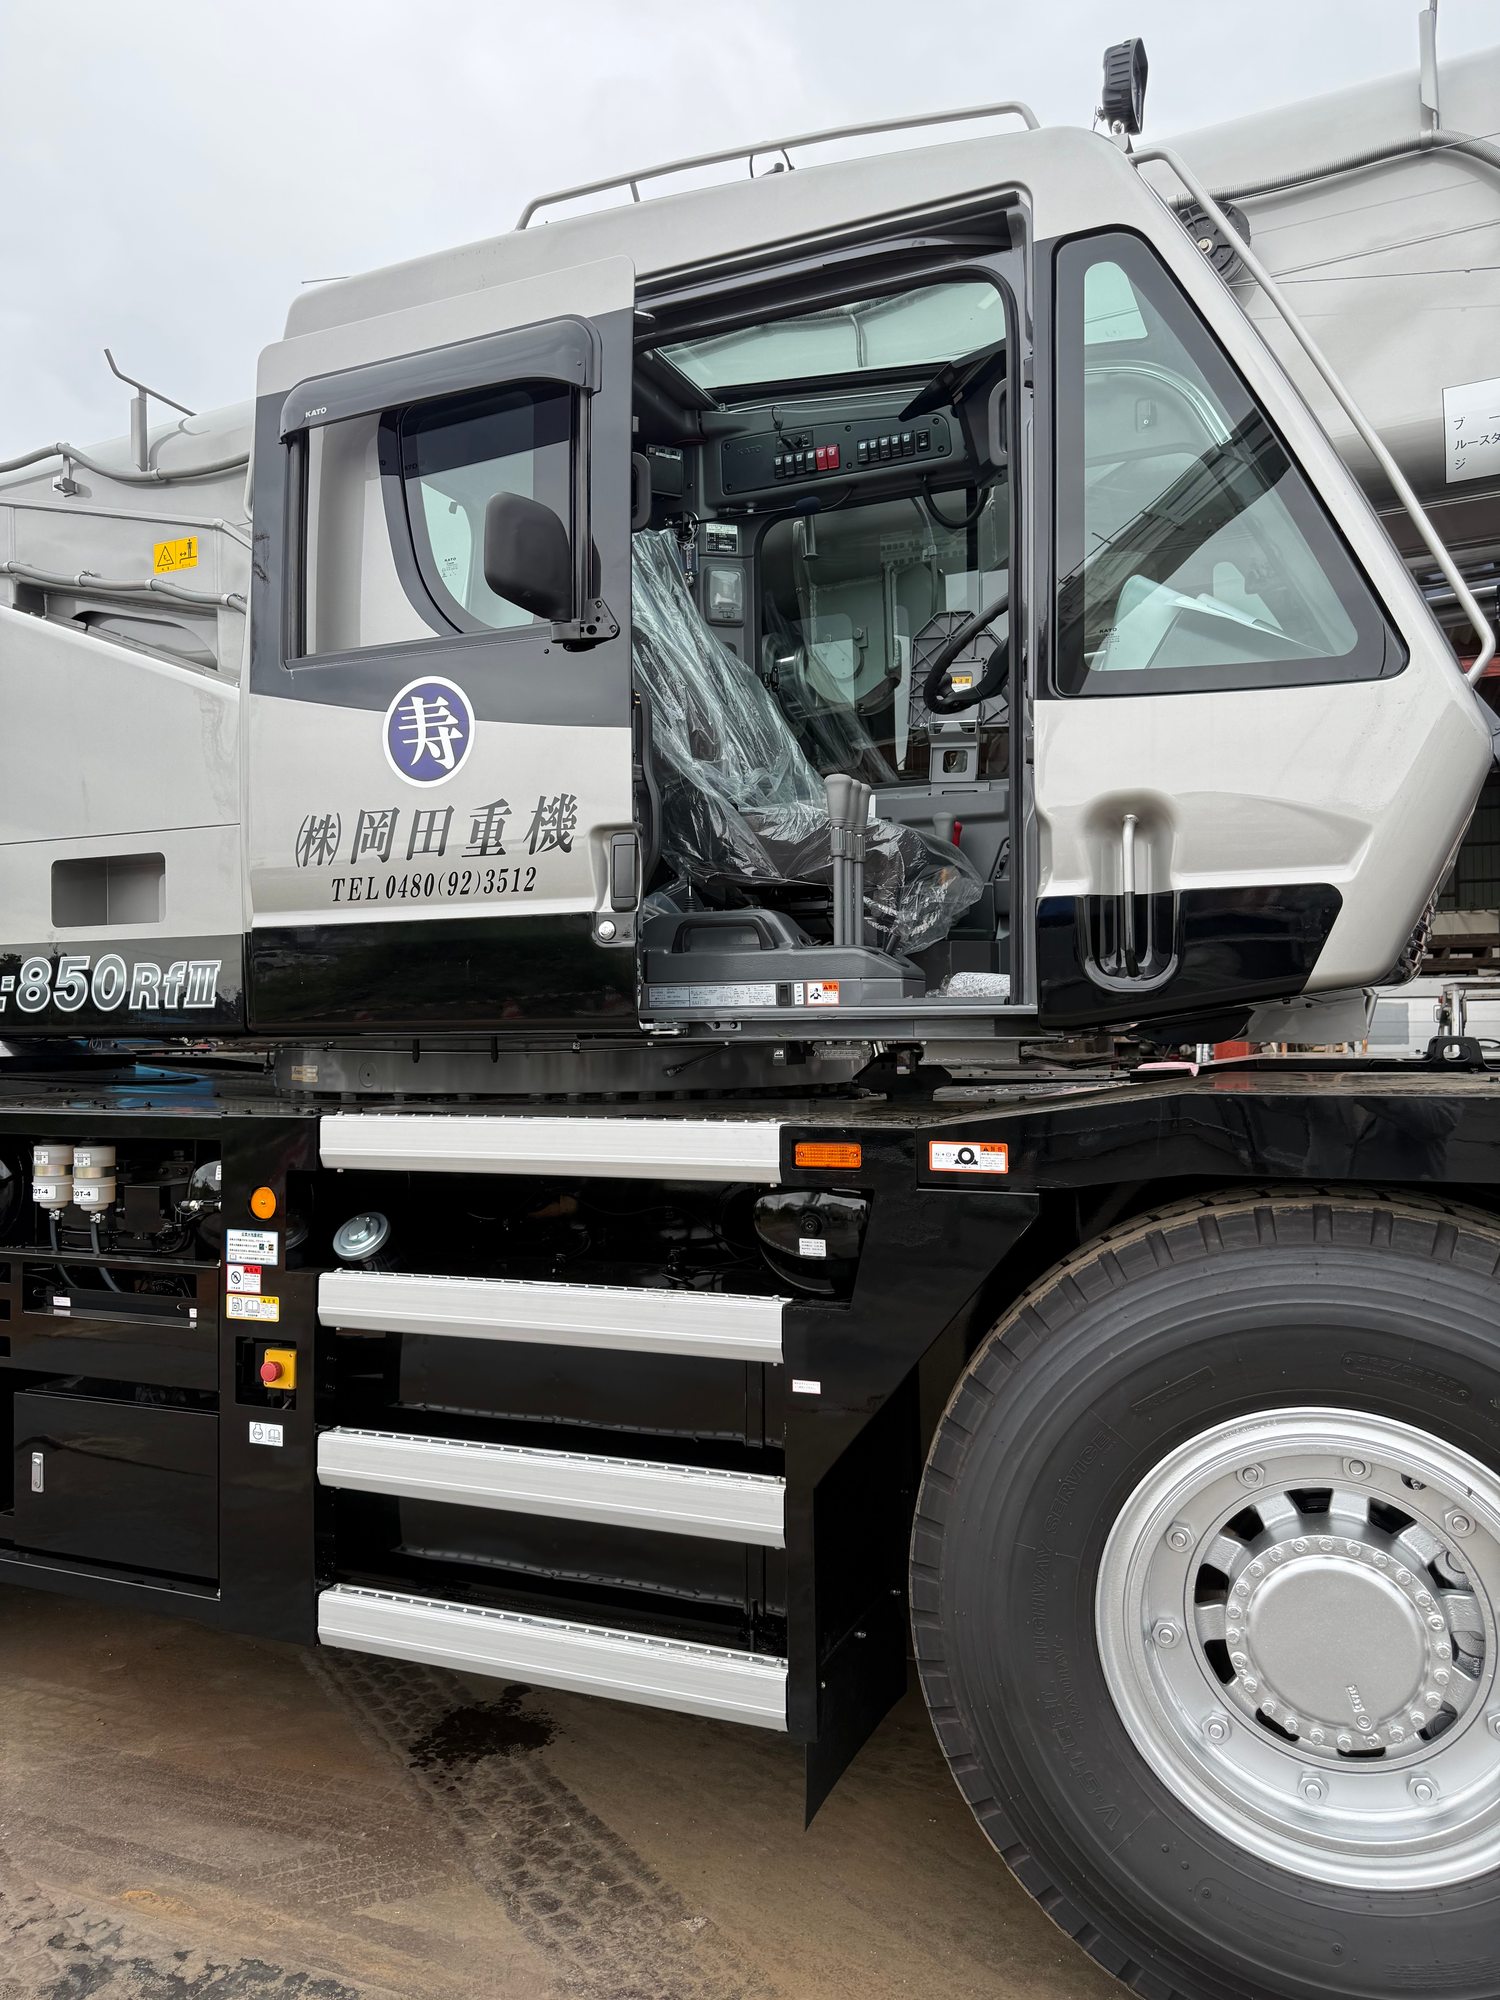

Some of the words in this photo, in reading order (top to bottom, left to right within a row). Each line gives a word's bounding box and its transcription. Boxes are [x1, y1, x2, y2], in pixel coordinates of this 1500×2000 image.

[305, 406, 327, 418] KATO
[1454, 457, 1467, 470] ジ
[398, 696, 464, 770] 寿
[1043, 1430, 1112, 1535] SERVICE
